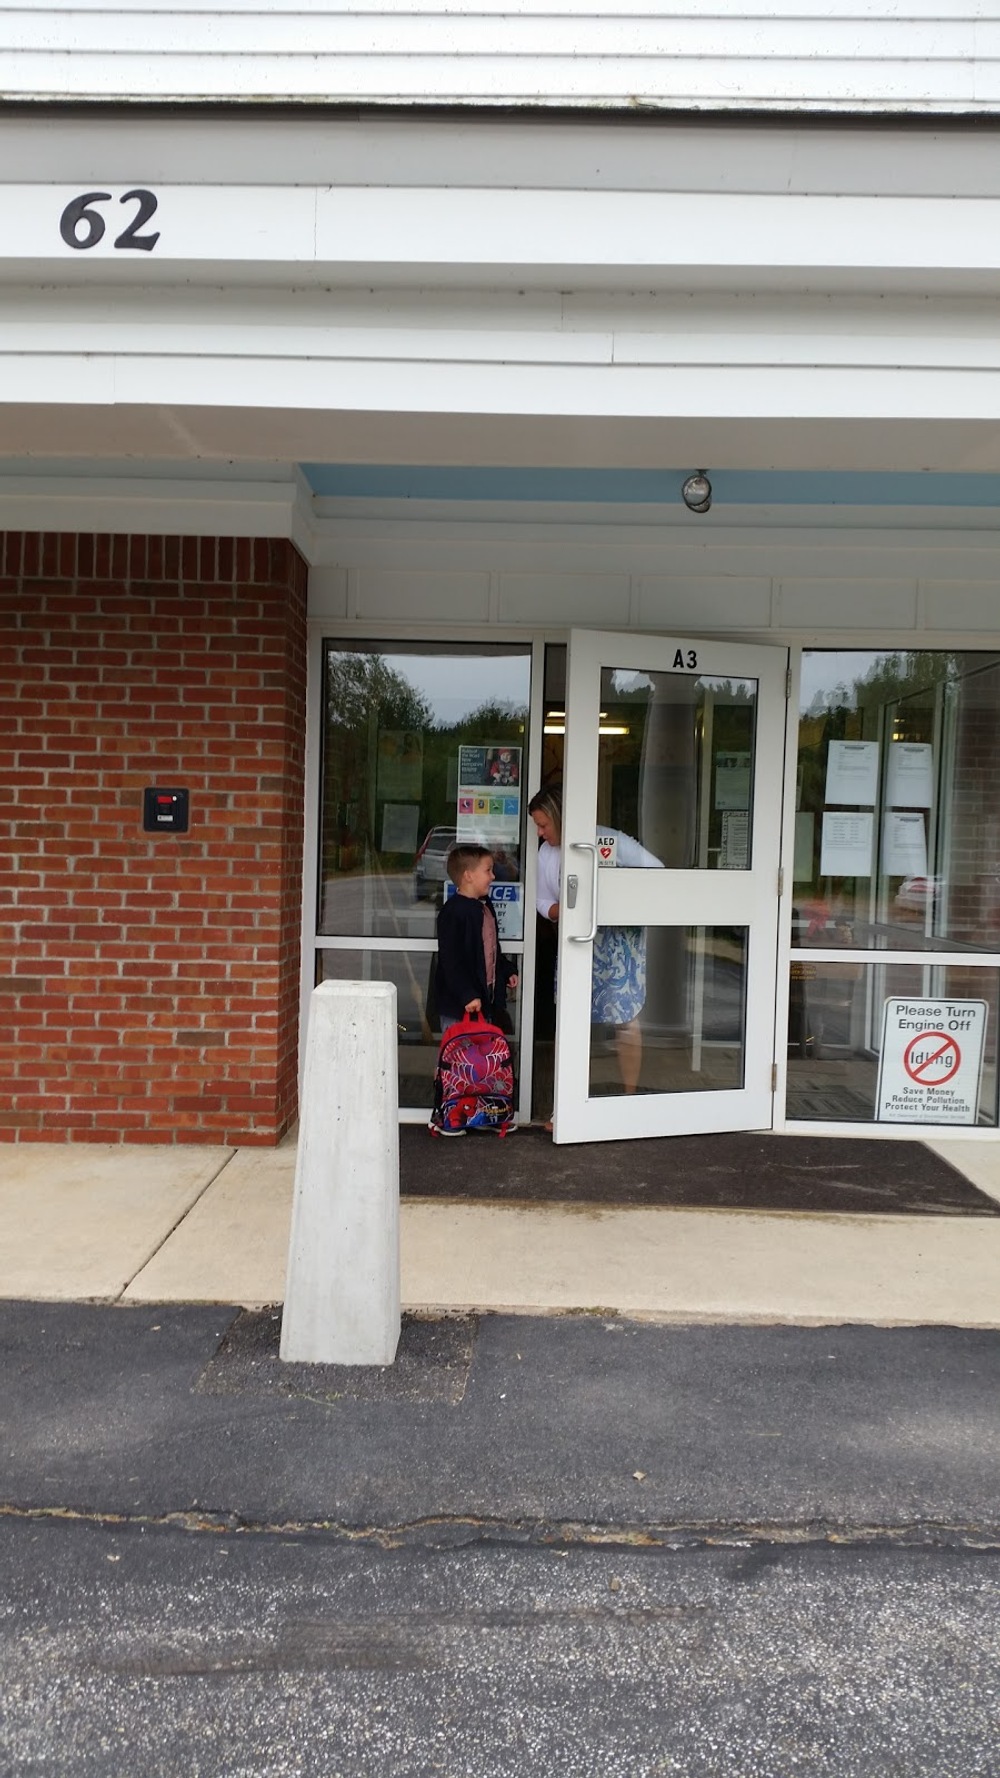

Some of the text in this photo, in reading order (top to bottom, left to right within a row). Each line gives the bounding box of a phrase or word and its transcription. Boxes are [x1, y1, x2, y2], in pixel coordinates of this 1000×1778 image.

[59, 188, 161, 251] 62
[672, 648, 698, 669] A3
[597, 837, 615, 846] AED
[488, 886, 513, 900] ICE
[896, 1005, 976, 1017] Please Turn
[898, 1019, 972, 1032] Engine Off
[903, 1087, 955, 1096] Save Money
[892, 1095, 965, 1104] Reduce Pollution
[885, 1102, 971, 1113] Protect Your Health
